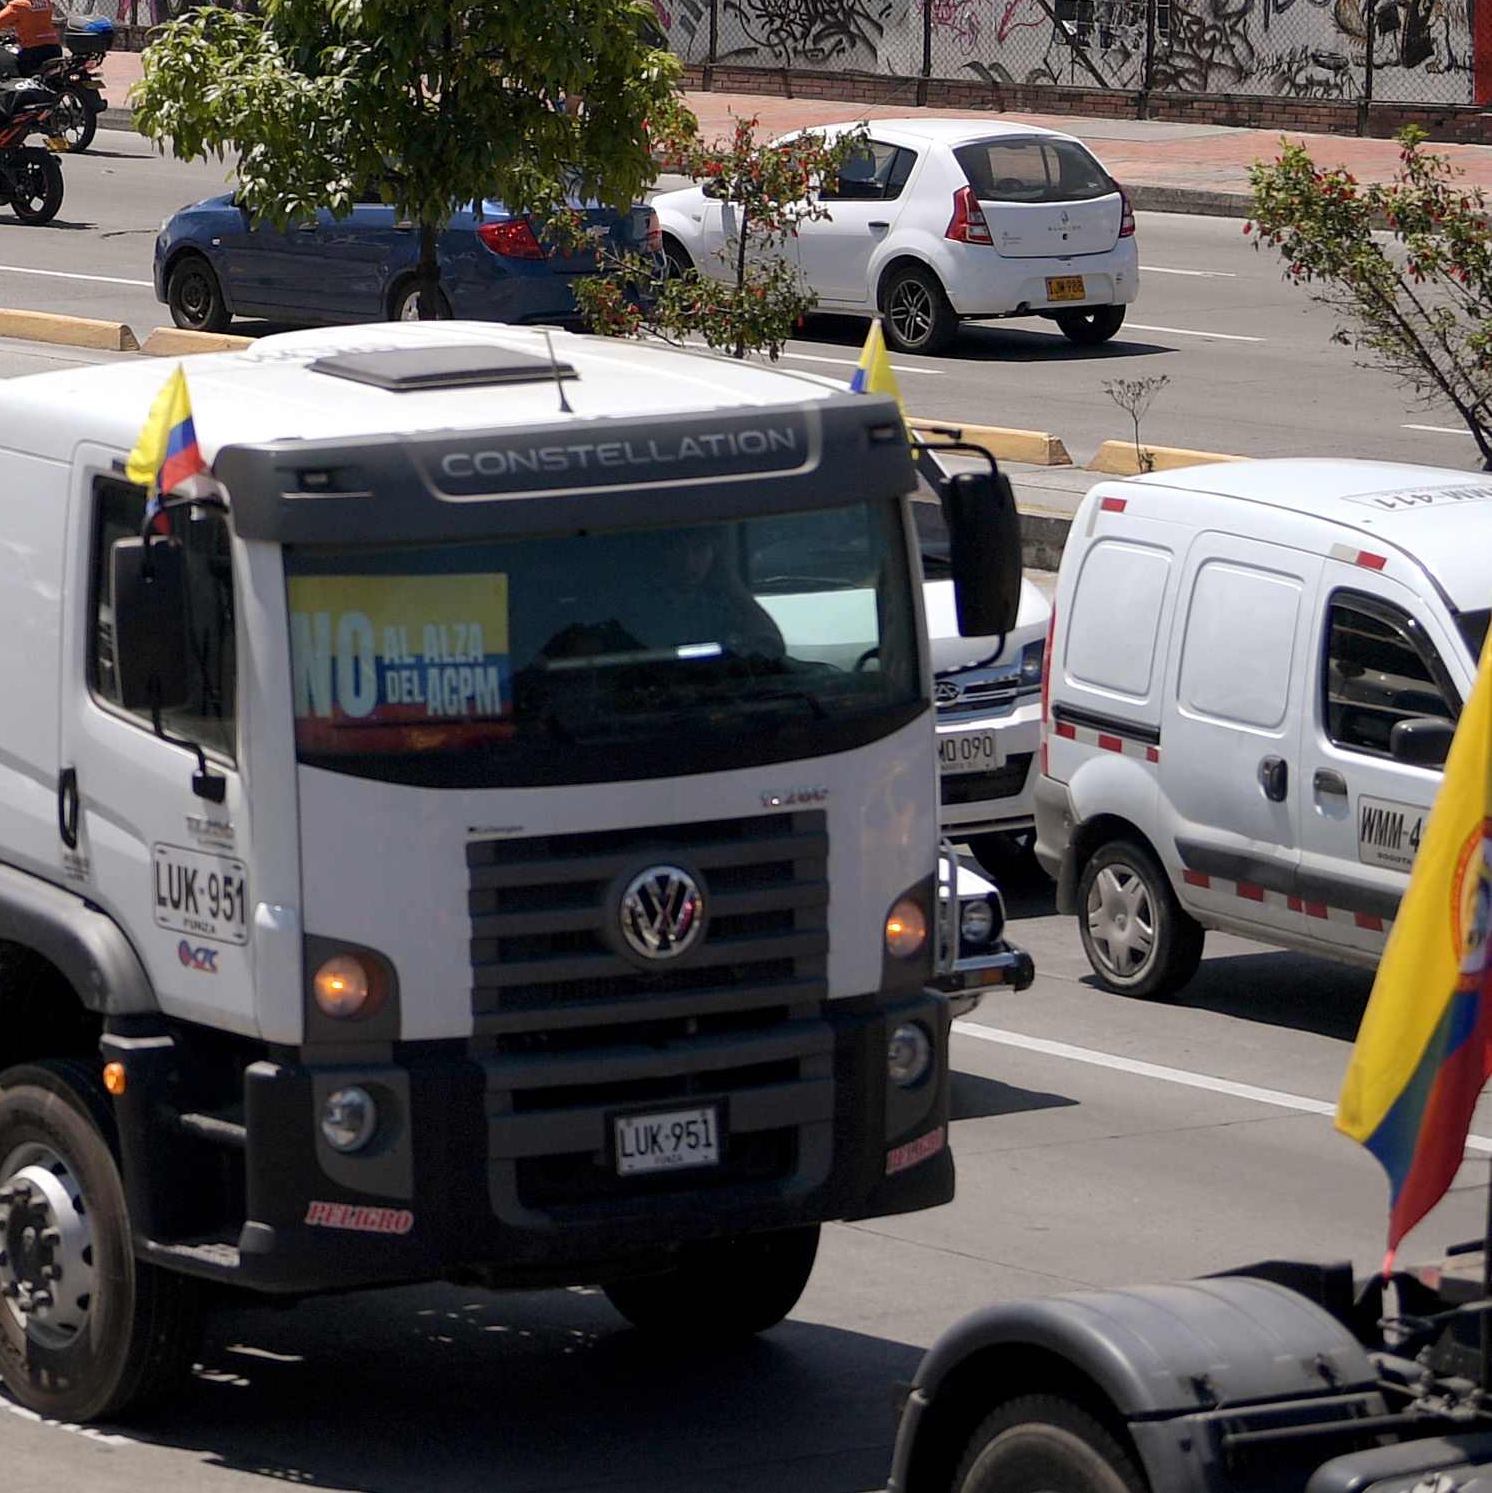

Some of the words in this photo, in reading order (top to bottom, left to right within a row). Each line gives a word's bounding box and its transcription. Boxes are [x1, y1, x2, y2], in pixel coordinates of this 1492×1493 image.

[440, 427, 797, 478] CONSTELLATION
[293, 609, 378, 718] NO
[382, 625, 416, 665] AL
[423, 621, 485, 664] ALZA
[385, 669, 427, 704] DEL
[426, 665, 503, 716] ACPM
[960, 735, 993, 760] 090
[304, 1200, 414, 1235] PELIGRO
